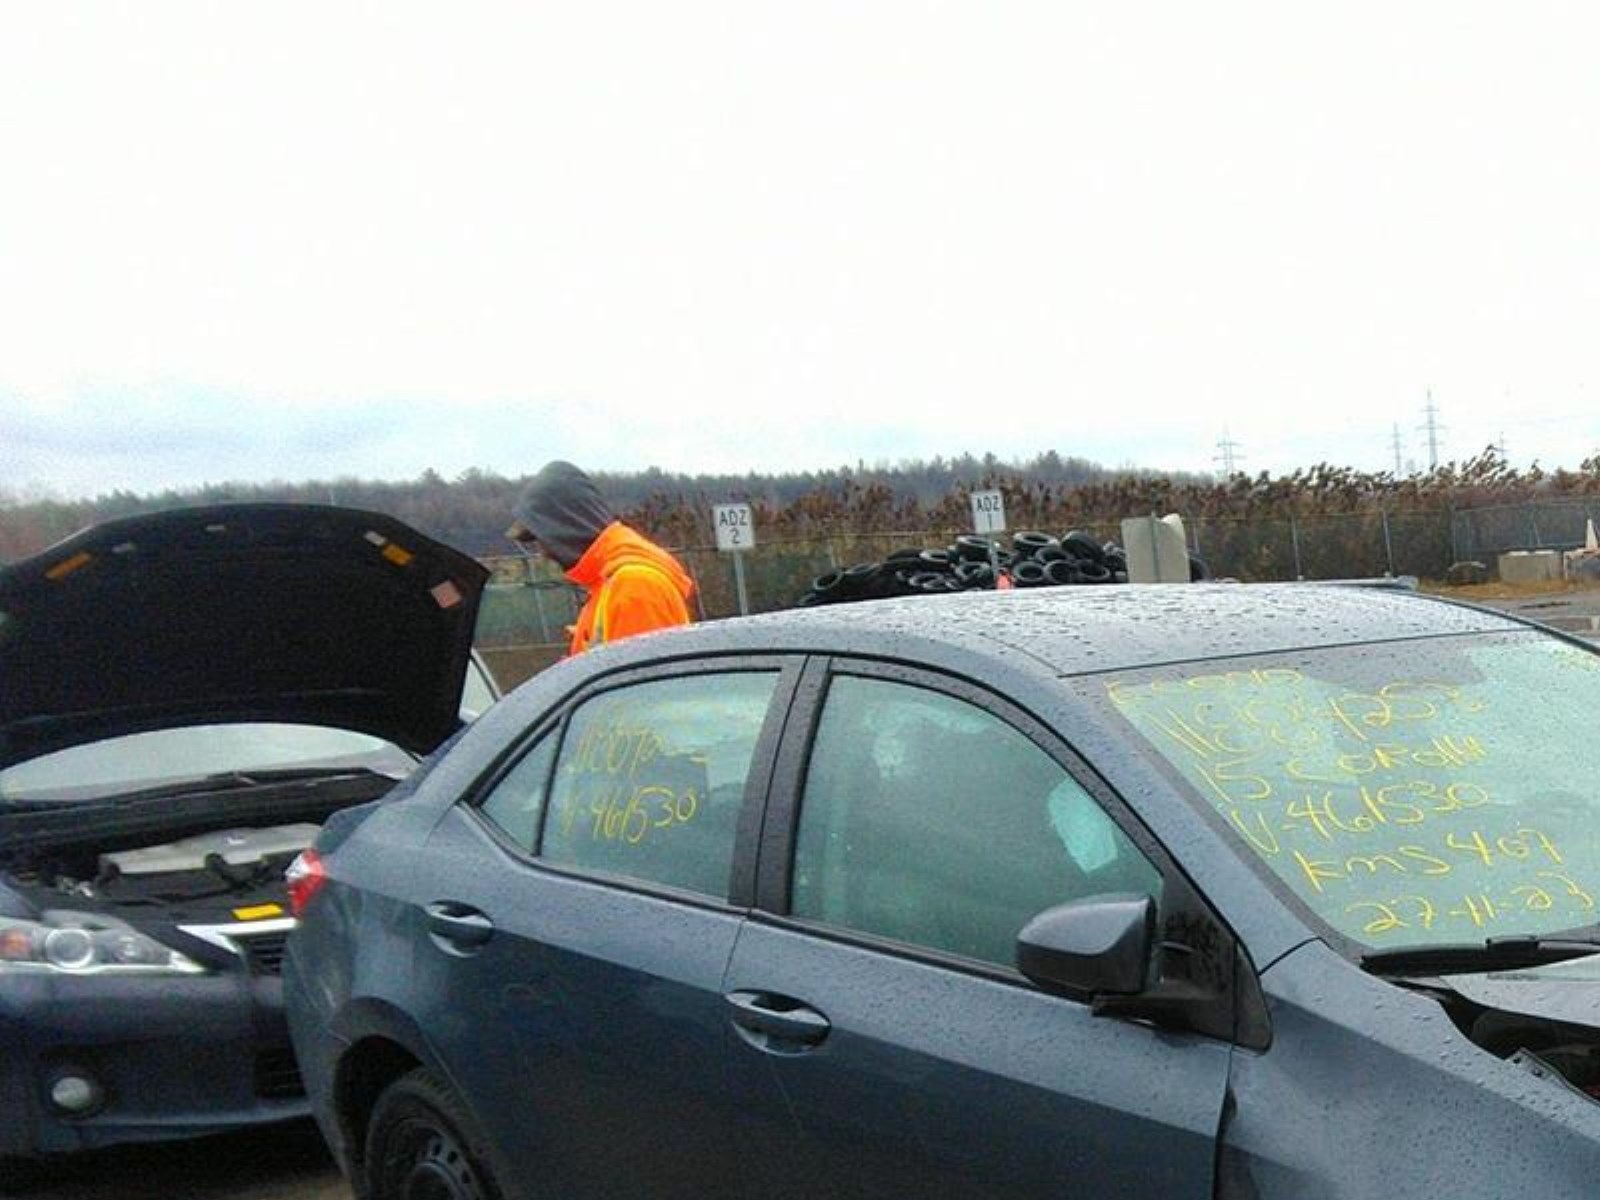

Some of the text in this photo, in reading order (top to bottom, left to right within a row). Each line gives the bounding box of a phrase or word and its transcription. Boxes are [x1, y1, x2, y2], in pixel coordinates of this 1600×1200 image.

[976, 494, 1000, 512] ADZ
[718, 508, 748, 526] ADZ
[730, 526, 741, 545] 2
